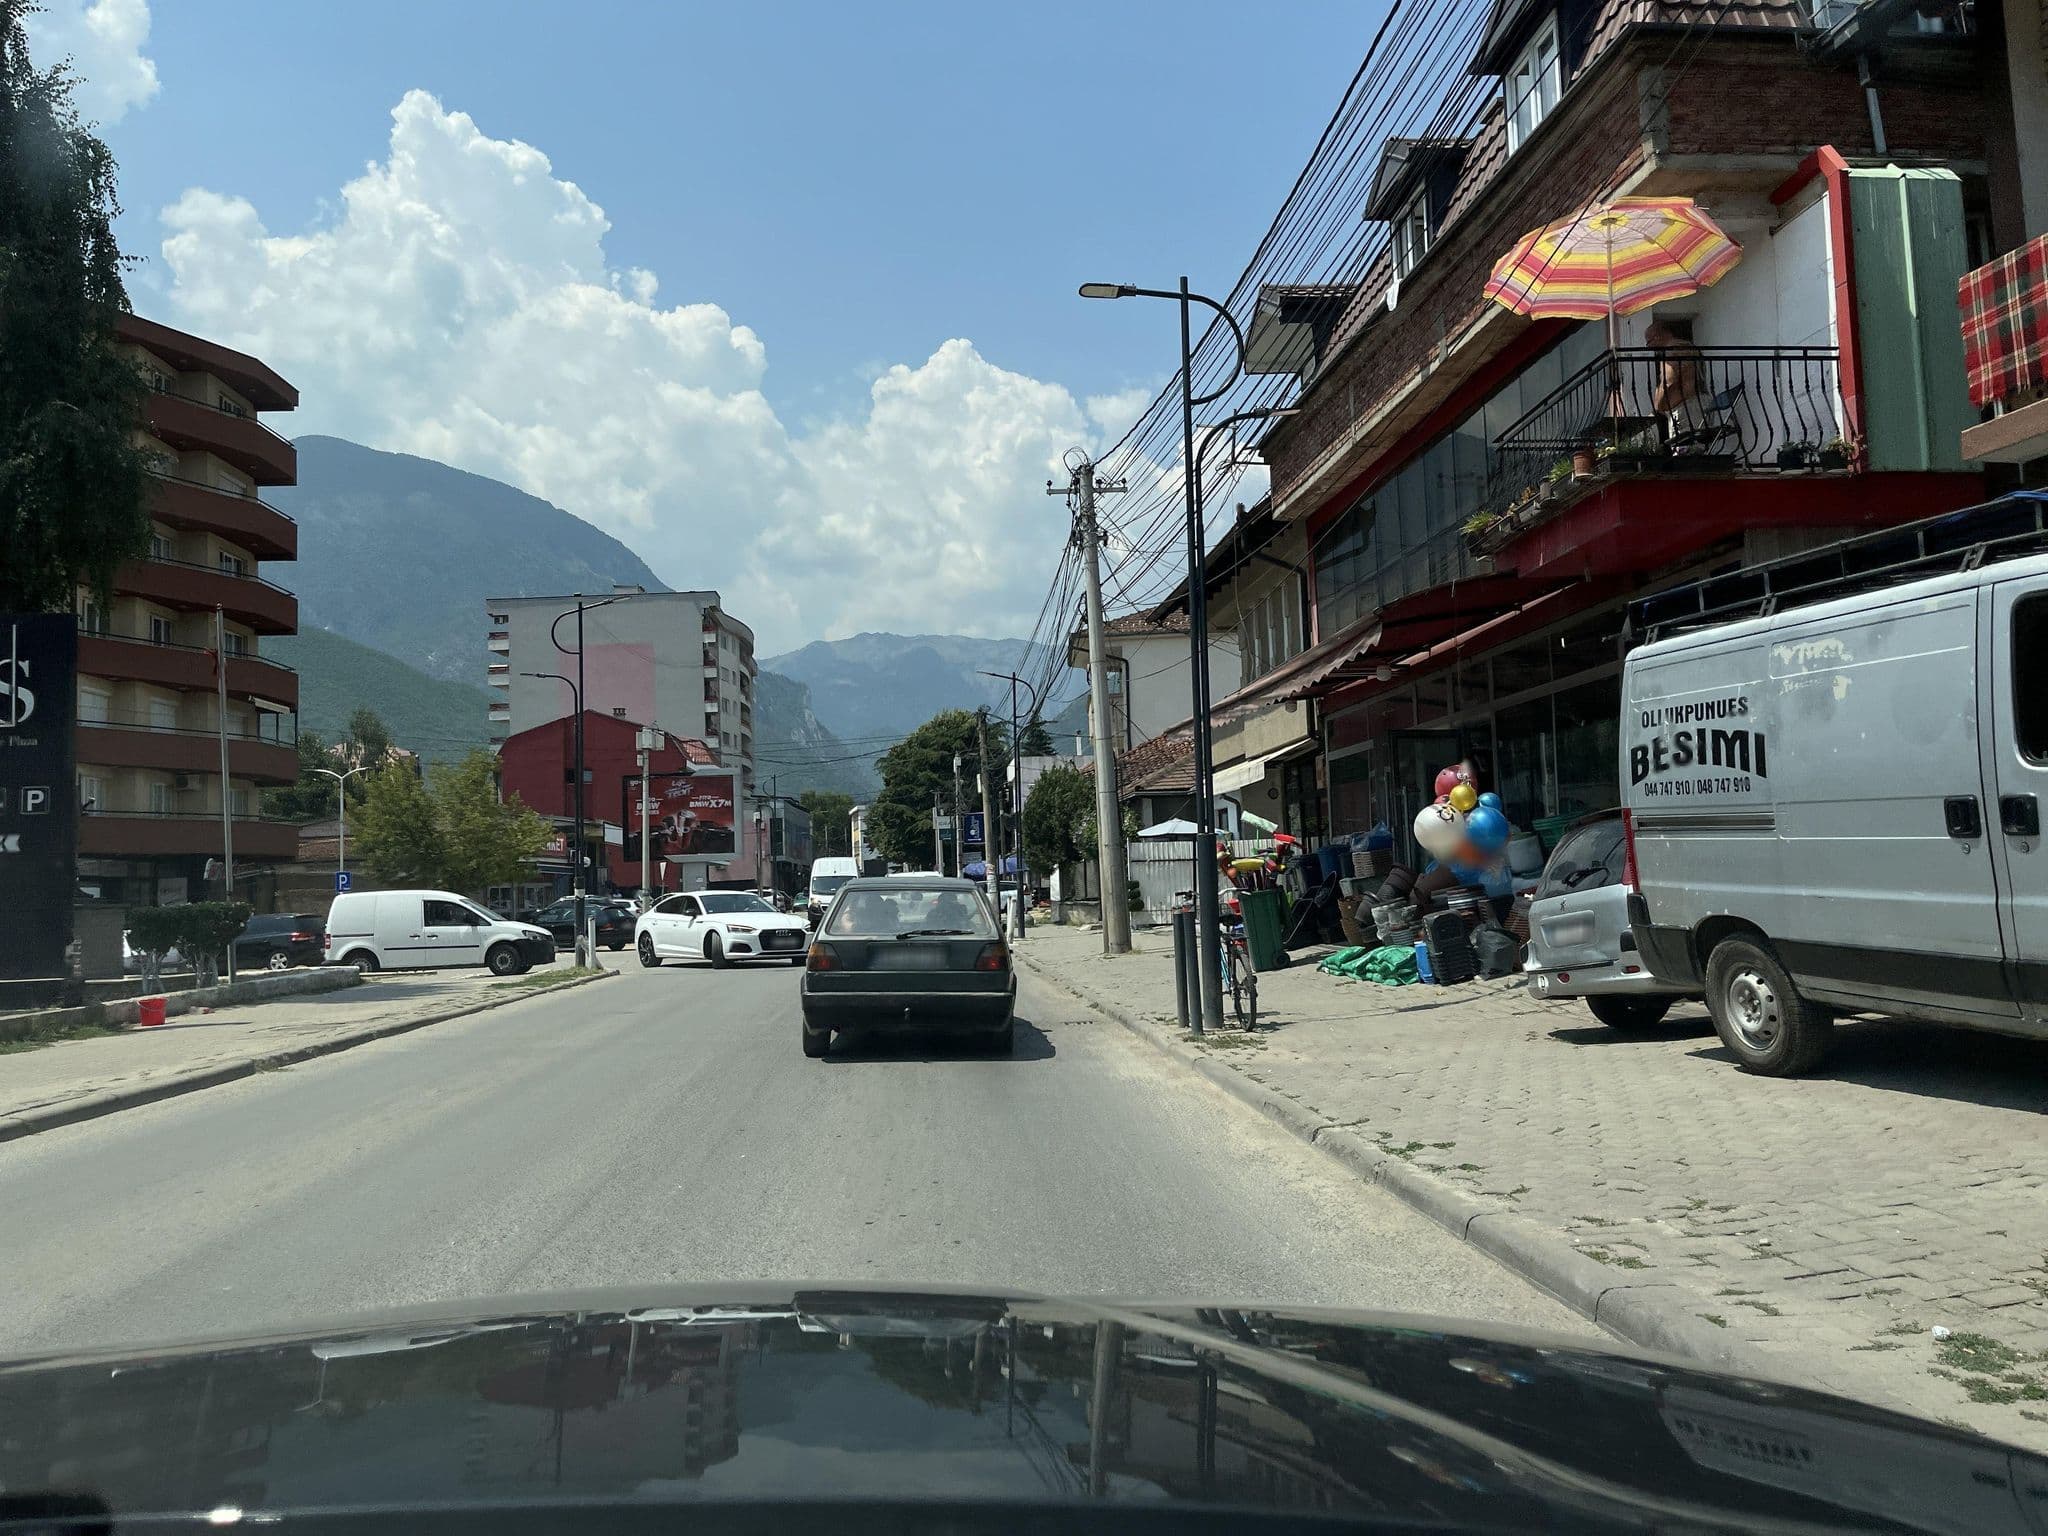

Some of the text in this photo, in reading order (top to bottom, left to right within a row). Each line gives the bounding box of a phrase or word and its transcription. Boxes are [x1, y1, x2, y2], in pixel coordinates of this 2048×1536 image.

[1630, 727, 1767, 786] BESIMI
[1644, 782, 1658, 796] 044
[1660, 781, 1673, 796] 747
[1675, 780, 1690, 794] 910
[1697, 779, 1713, 794] 048
[1716, 778, 1730, 793] 747
[27, 790, 44, 811] P
[339, 874, 348, 890] P
